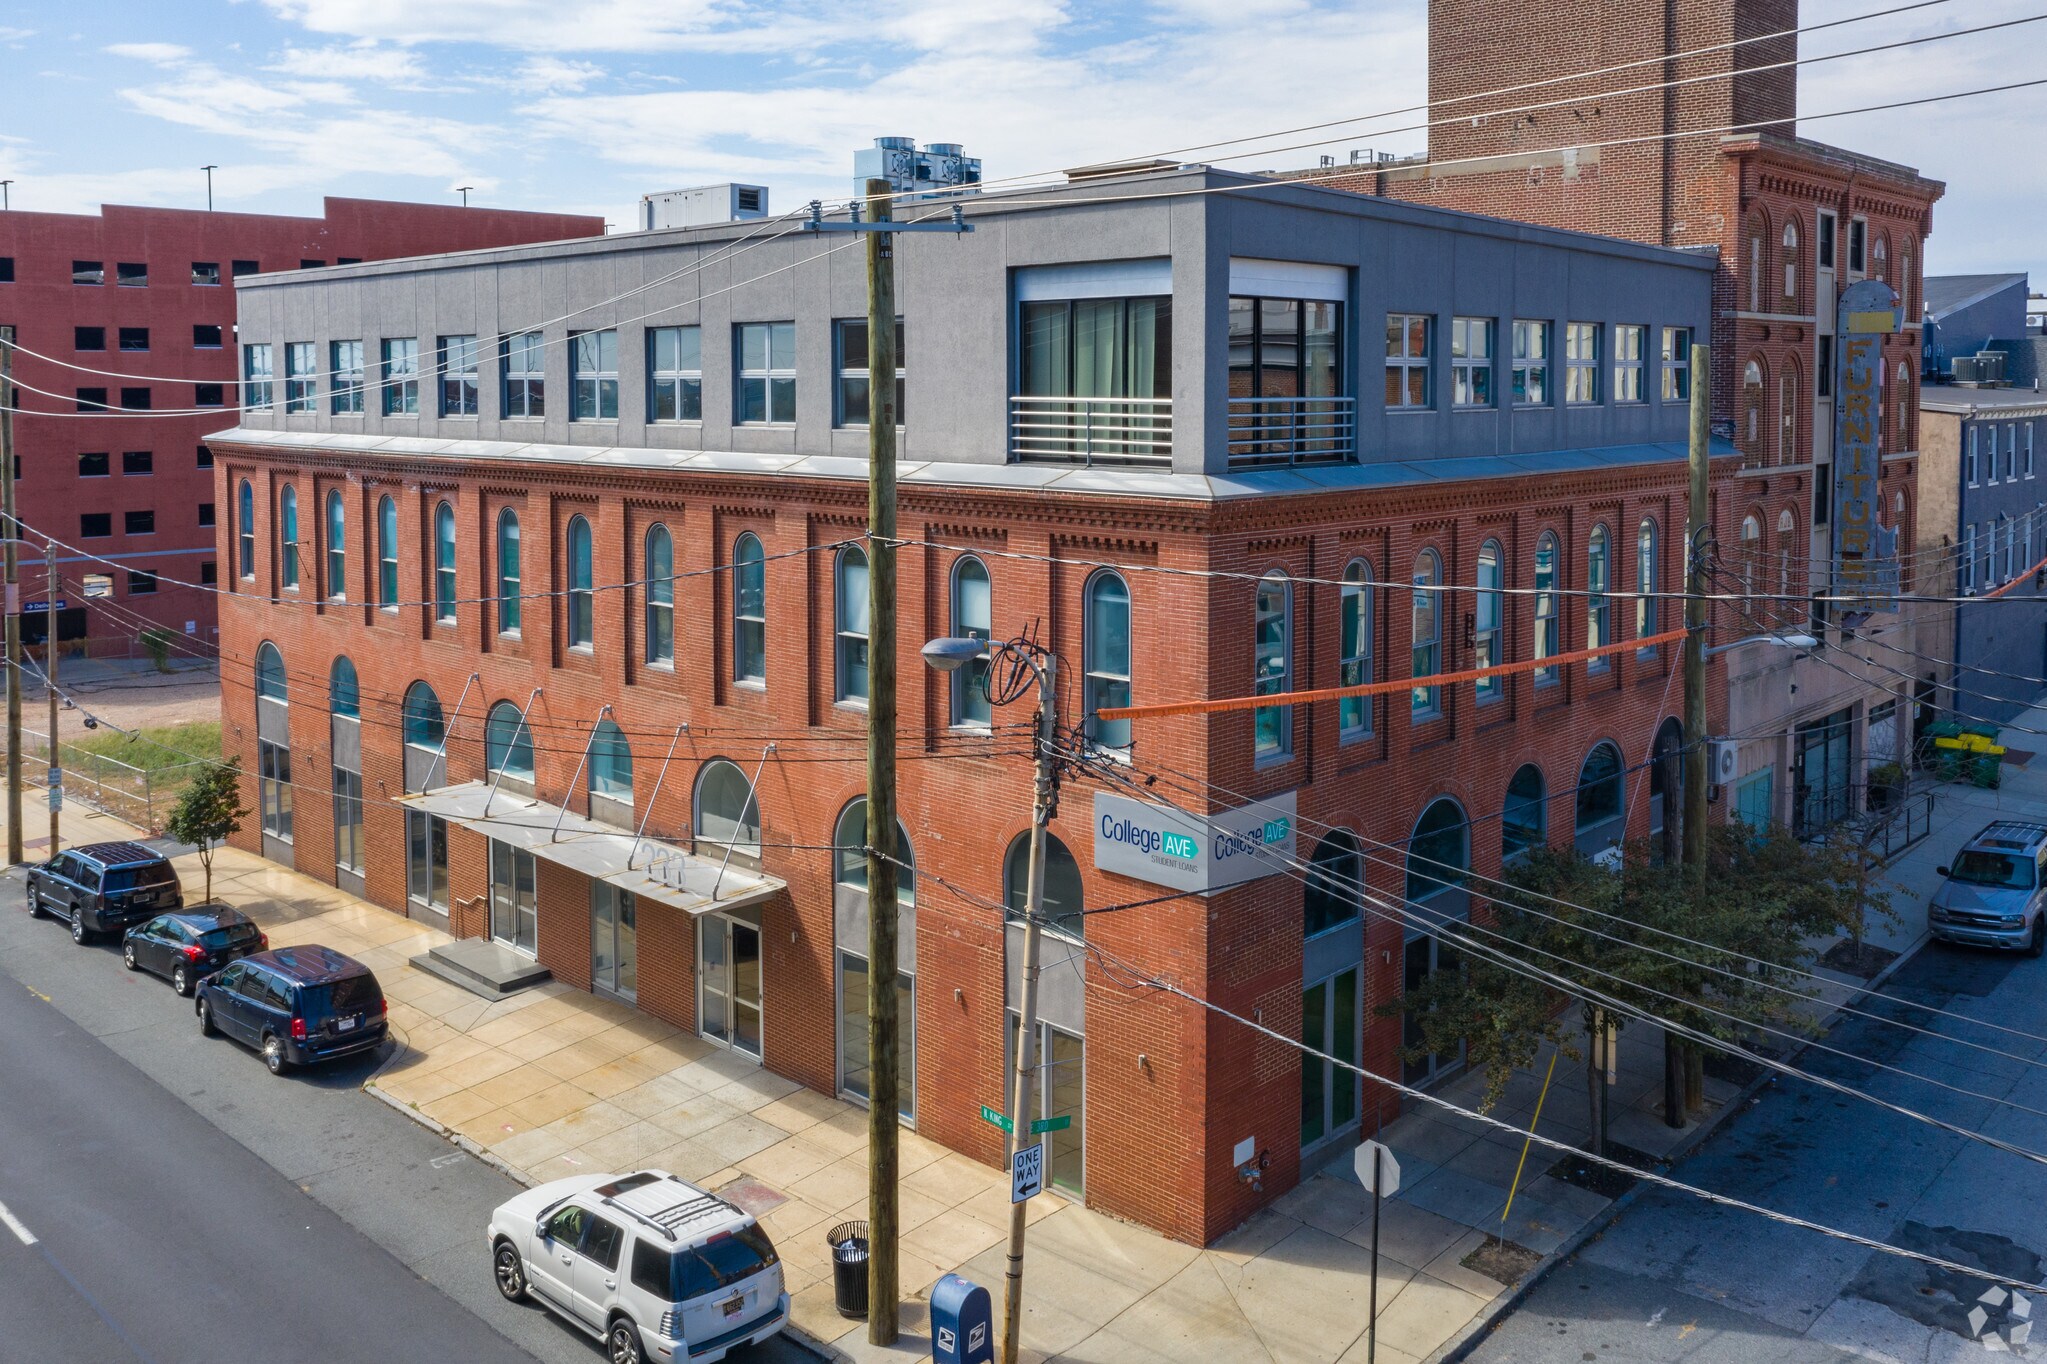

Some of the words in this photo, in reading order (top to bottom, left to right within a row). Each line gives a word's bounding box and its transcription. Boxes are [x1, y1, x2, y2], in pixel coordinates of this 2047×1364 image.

[1841, 338, 1873, 581] FURNITURE
[34, 602, 64, 610] Delives
[1101, 814, 1160, 854] College
[1165, 836, 1191, 858] AVE
[1214, 827, 1263, 861] College
[1265, 820, 1285, 843] AVE
[1151, 855, 1178, 870] STUDENT
[1178, 862, 1198, 874] LOANS
[989, 1110, 1003, 1126] KING
[1037, 1120, 1049, 1132] 3RD
[1017, 1149, 1039, 1168] ONE
[1016, 1163, 1040, 1182] WAY
